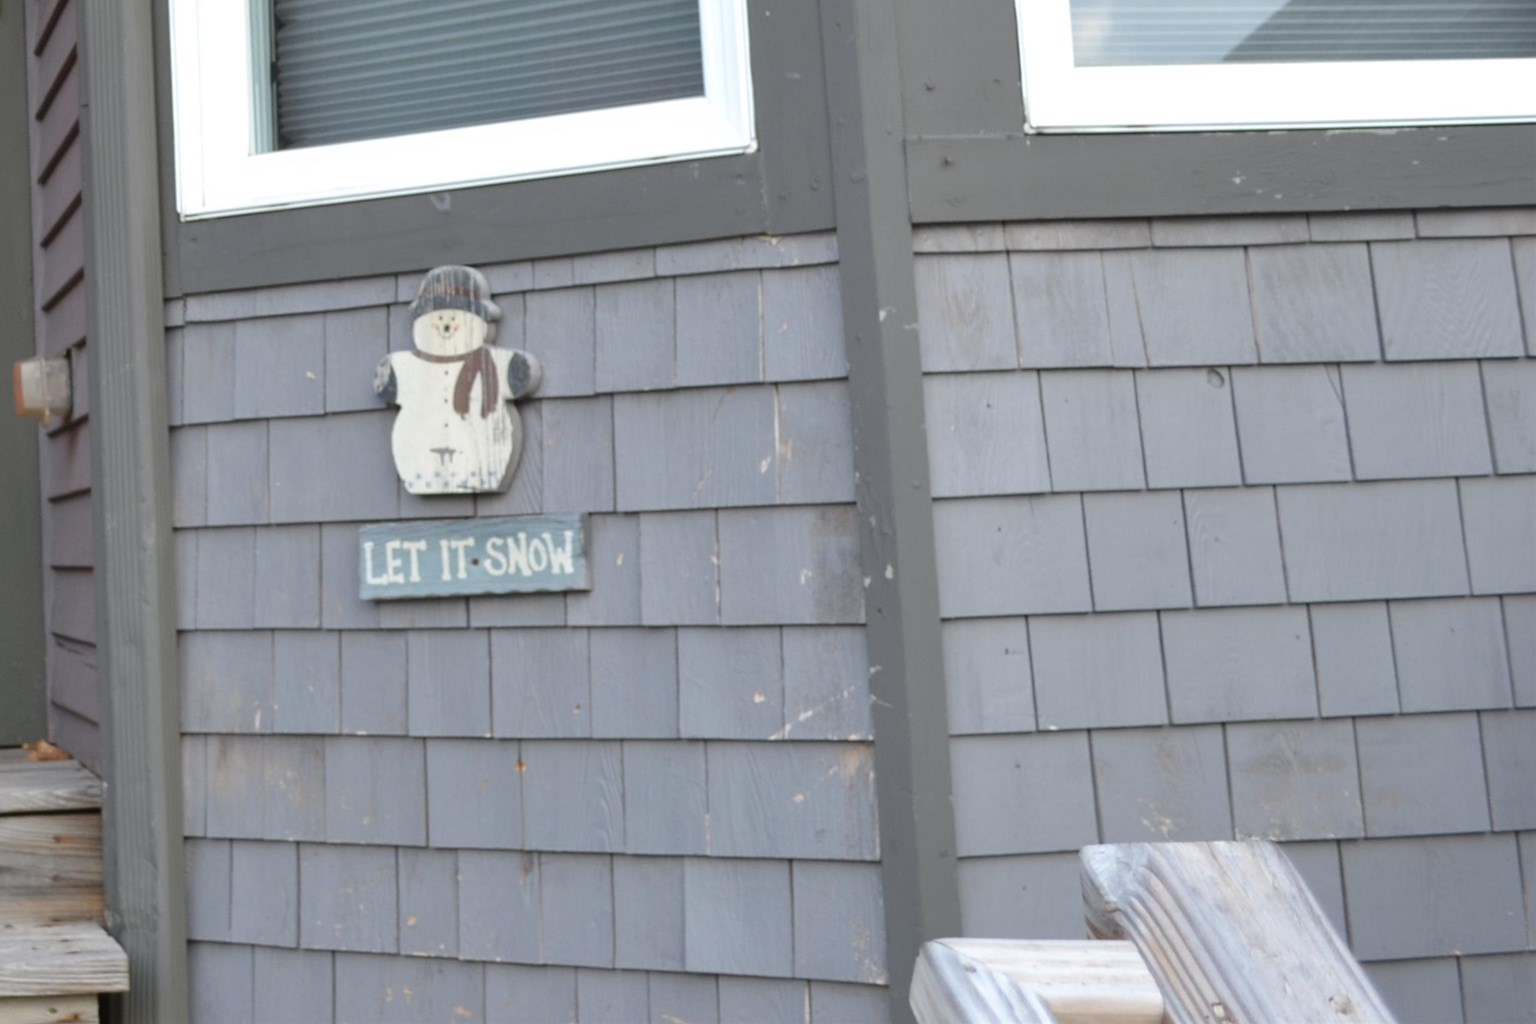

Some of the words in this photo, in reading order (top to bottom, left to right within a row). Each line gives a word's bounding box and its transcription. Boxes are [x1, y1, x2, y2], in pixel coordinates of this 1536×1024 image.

[365, 540, 426, 585] LET
[440, 537, 474, 581] IT
[483, 531, 575, 577] SNOW
